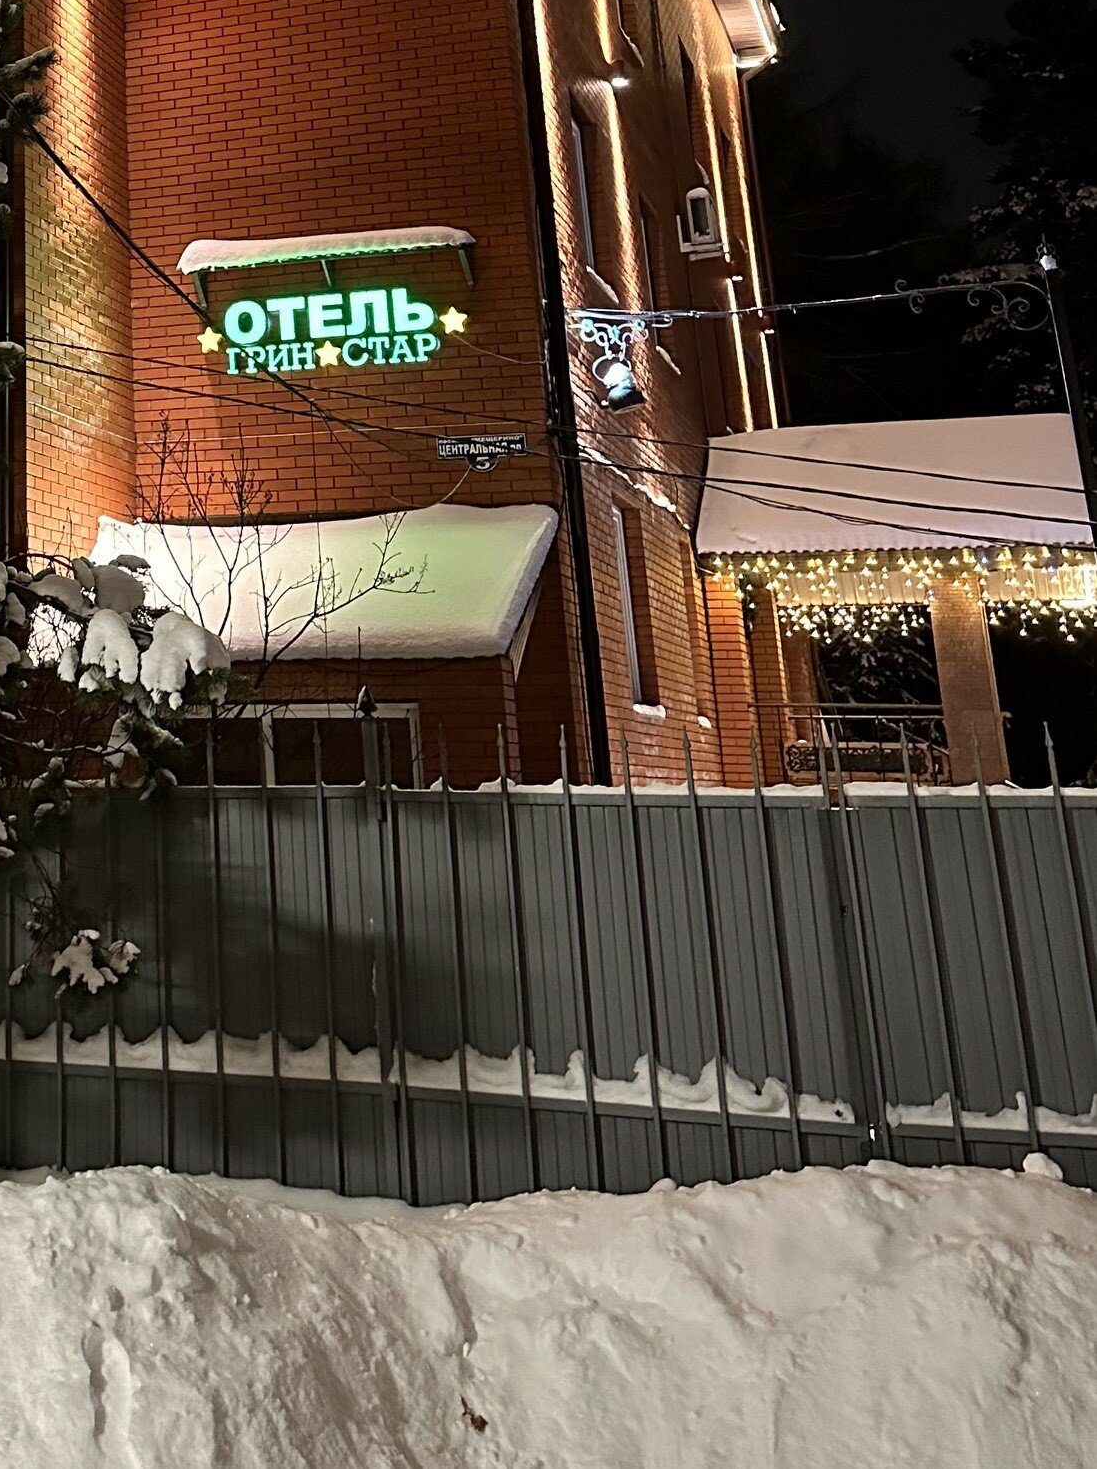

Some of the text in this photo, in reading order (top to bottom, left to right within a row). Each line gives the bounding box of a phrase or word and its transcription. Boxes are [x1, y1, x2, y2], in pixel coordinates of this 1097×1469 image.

[224, 288, 436, 345] ОТЕЛЬ
[226, 333, 439, 374] ГРИН СТАР
[476, 456, 490, 470] 5
